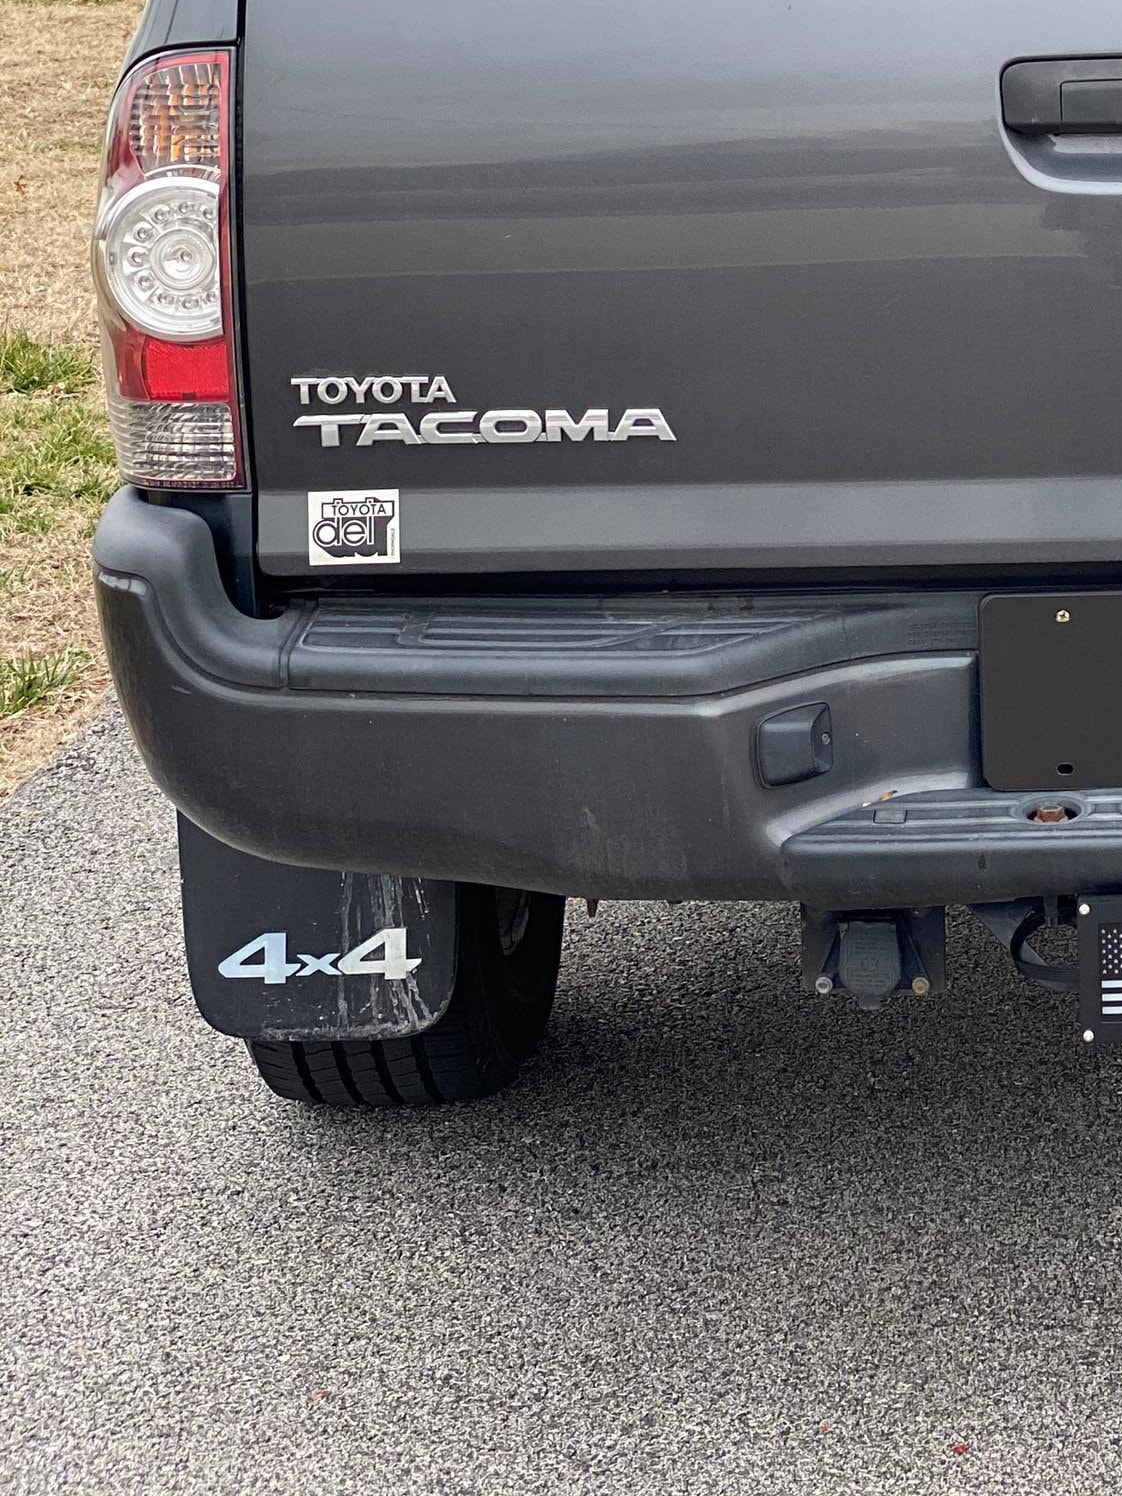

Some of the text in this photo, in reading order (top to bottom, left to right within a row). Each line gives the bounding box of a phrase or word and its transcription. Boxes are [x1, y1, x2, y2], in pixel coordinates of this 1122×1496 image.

[290, 375, 457, 404] TOYOTA
[293, 407, 678, 448] TACOMA
[331, 503, 387, 516] TOYOTA
[217, 926, 423, 985] 4x4
